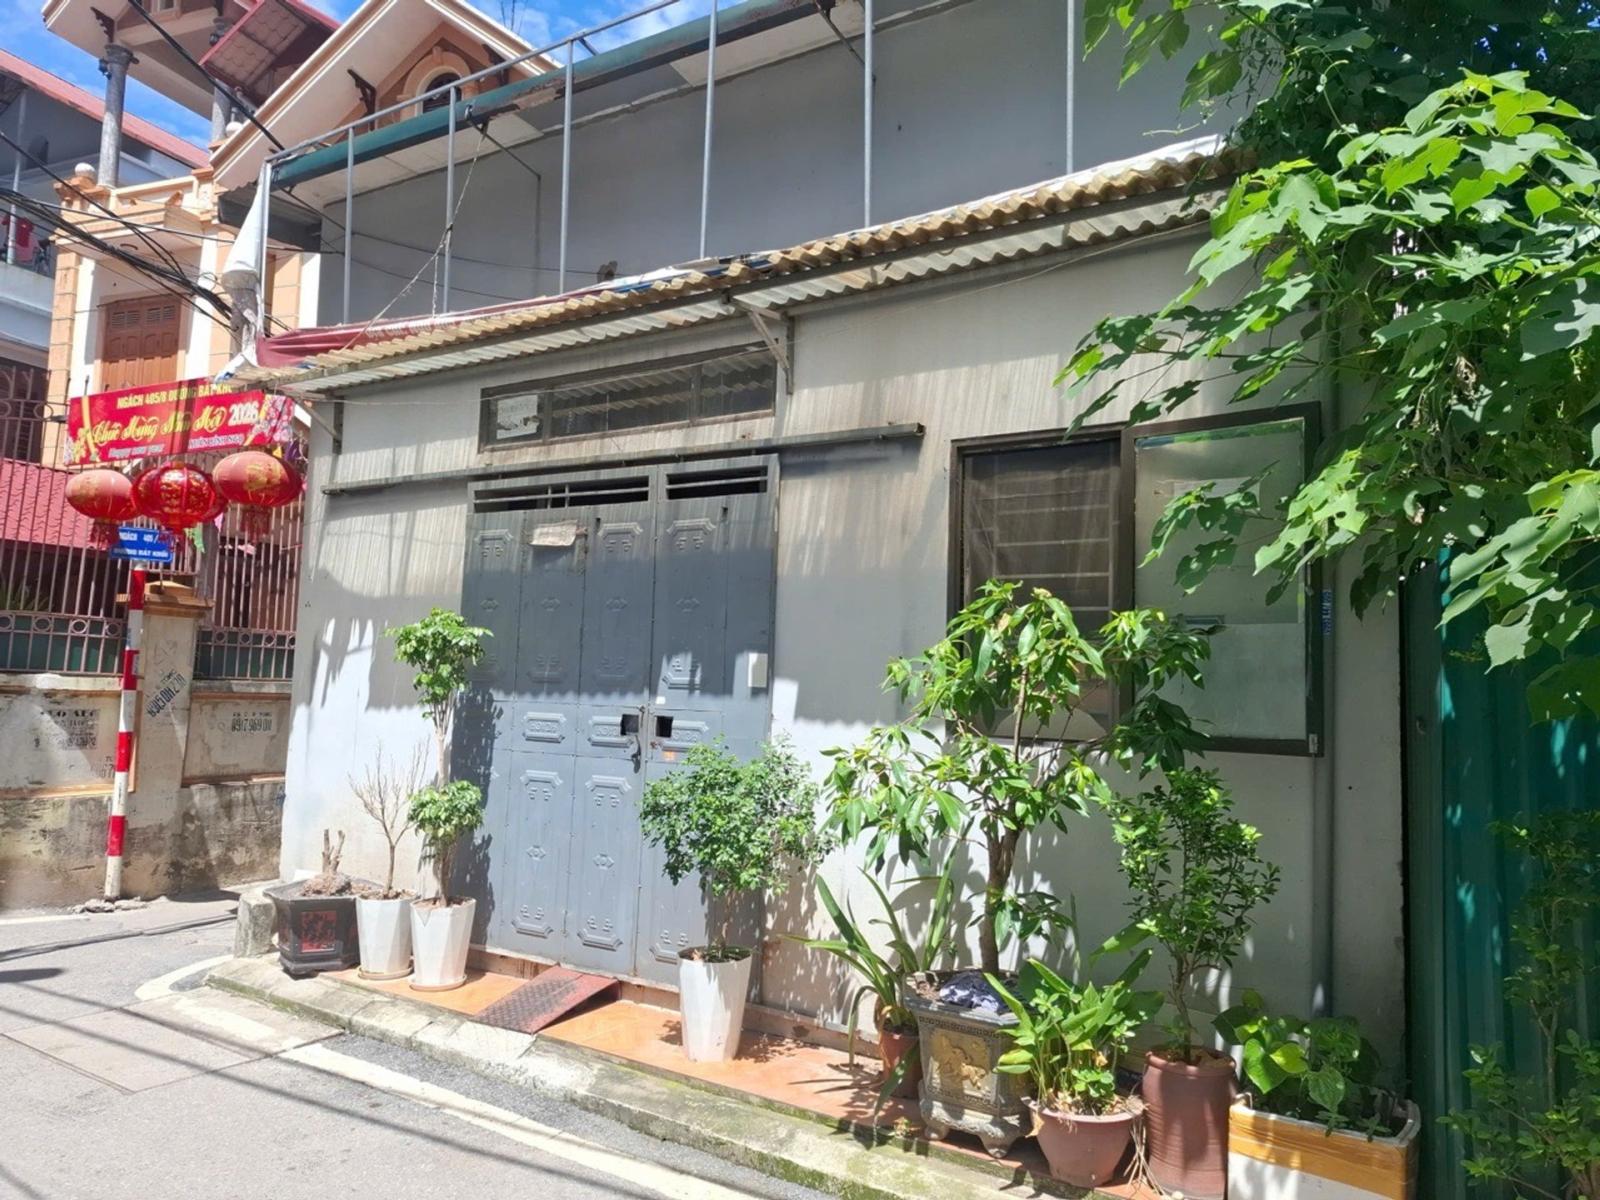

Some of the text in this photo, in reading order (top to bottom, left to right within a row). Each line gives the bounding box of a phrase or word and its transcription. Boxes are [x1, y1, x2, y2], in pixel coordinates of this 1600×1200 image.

[93, 420, 121, 447] Chúc
[121, 415, 160, 443] Mừng
[193, 405, 227, 433] Mới
[228, 400, 259, 426] 2026
